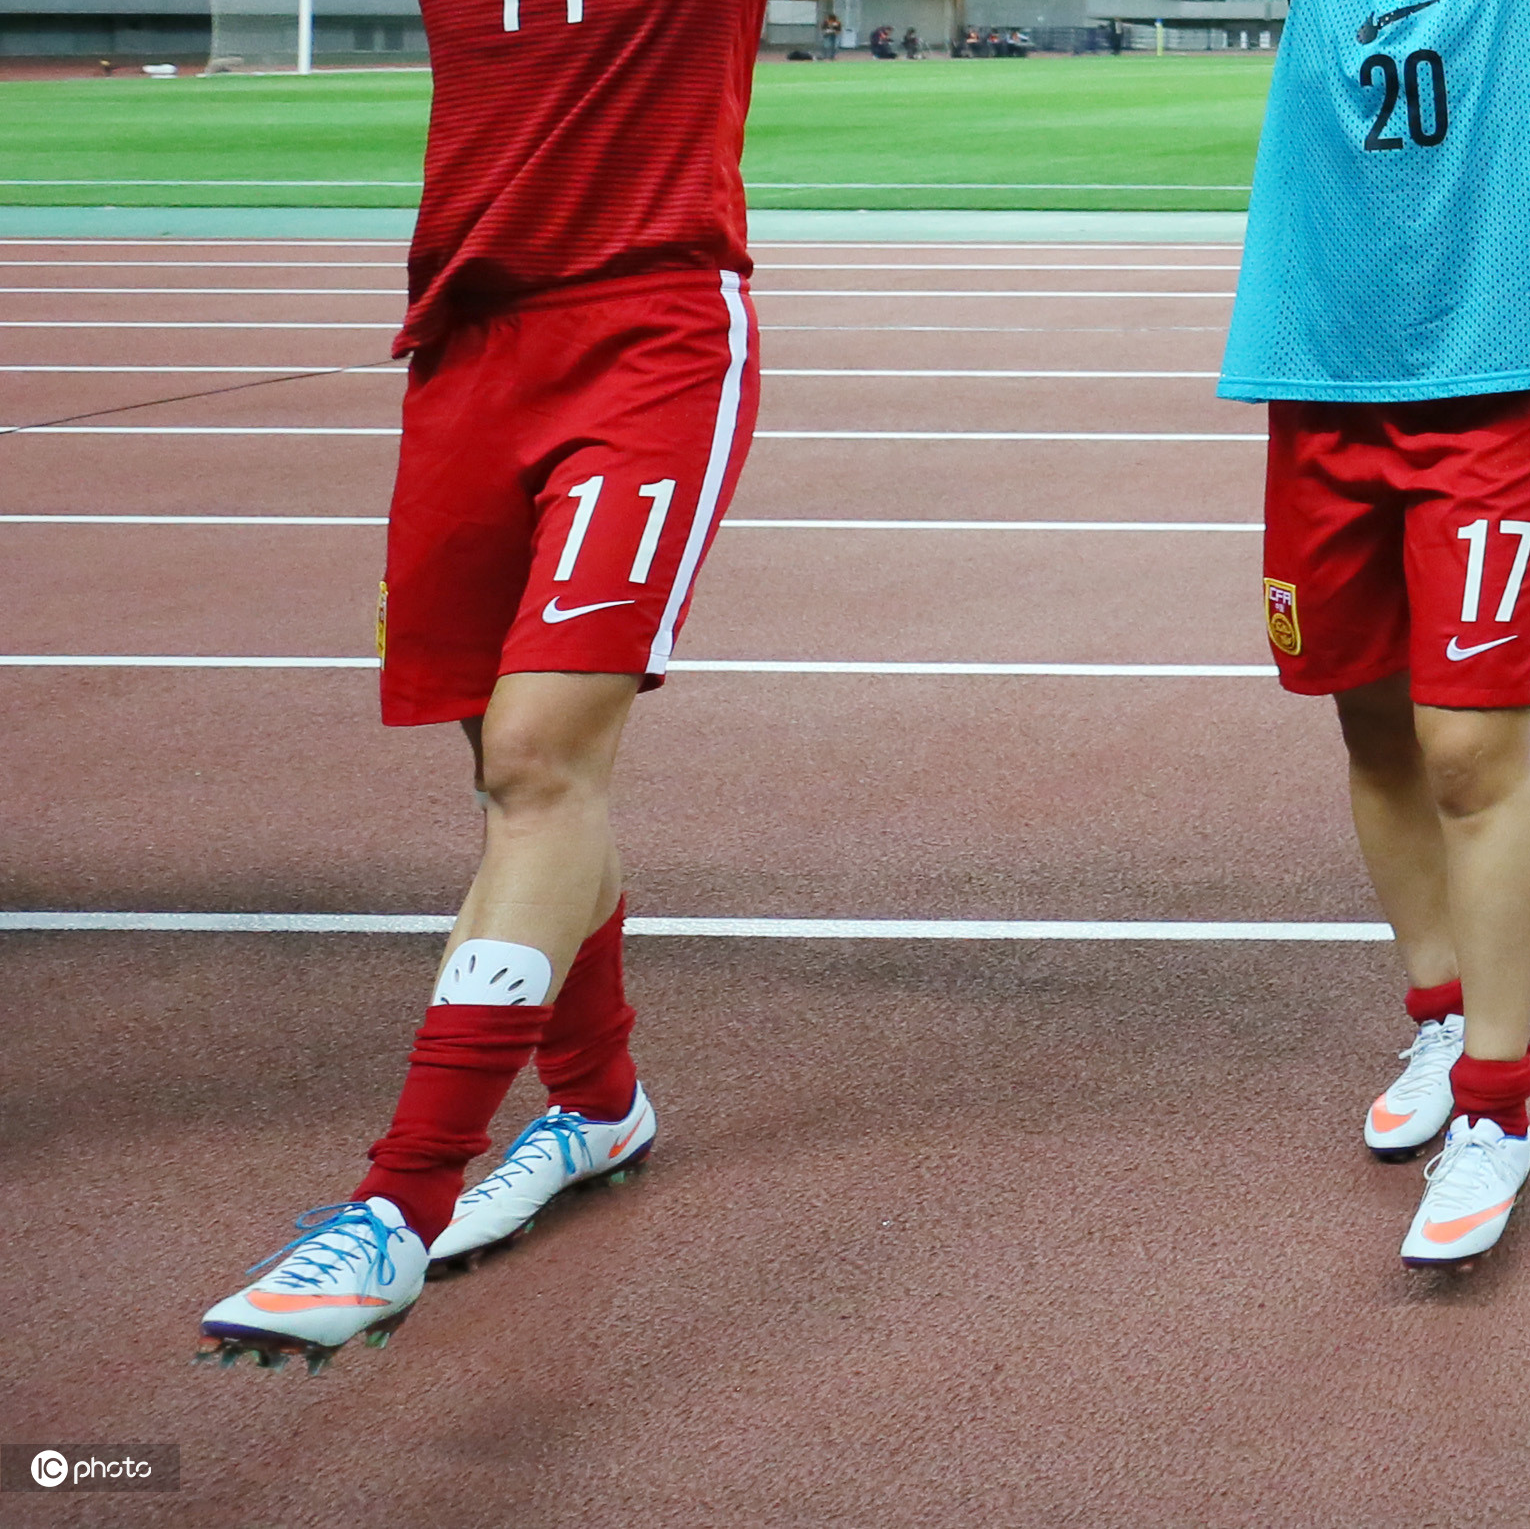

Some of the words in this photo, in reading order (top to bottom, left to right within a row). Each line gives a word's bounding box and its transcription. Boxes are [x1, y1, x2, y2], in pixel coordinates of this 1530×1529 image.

[1360, 49, 1448, 151] 20
[553, 476, 676, 584] 11
[1269, 586, 1292, 606] CFA
